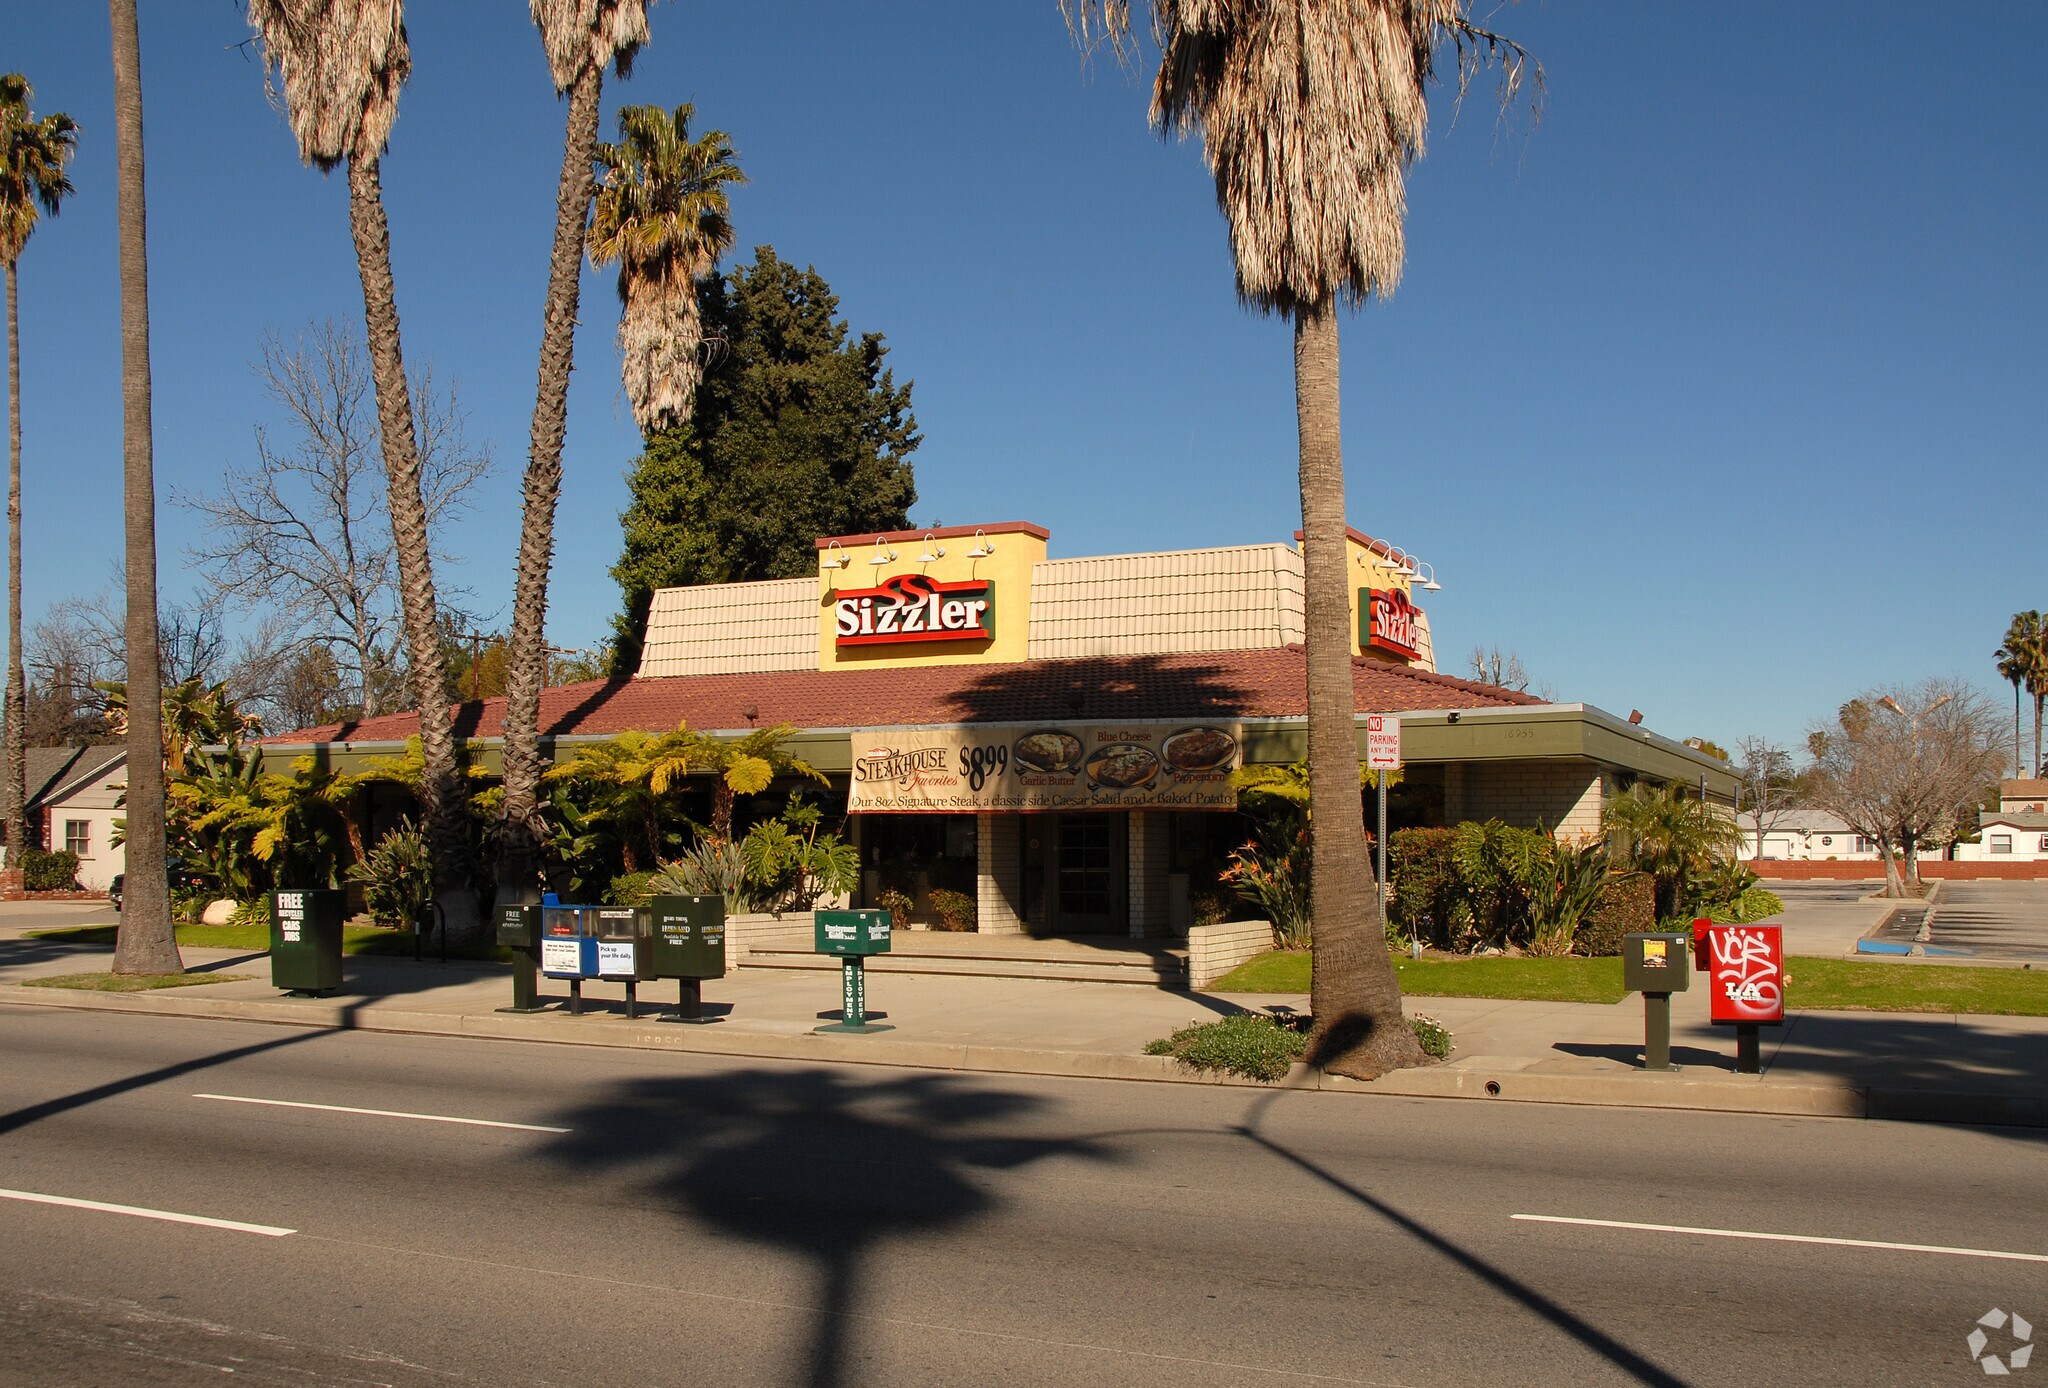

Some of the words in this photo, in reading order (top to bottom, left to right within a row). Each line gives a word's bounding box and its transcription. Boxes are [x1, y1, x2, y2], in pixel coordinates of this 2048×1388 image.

[835, 593, 987, 636] Sizzler
[1376, 600, 1421, 651] Sizzler
[1369, 717, 1381, 730] NO
[1097, 731, 1118, 742] Blue
[1119, 731, 1152, 741] Cheese
[1369, 734, 1398, 745] PARKING
[1384, 747, 1397, 755] TIME
[855, 750, 947, 782] STEAKHOUSE
[898, 769, 959, 792] Favorites
[1020, 776, 1047, 786] Garlic
[1048, 776, 1076, 786] Butter
[851, 796, 873, 807] Our
[875, 796, 897, 807] 8oz.
[898, 795, 948, 809] Signature
[950, 795, 982, 808] Steak,
[983, 798, 989, 806] a
[991, 794, 1026, 806] classic
[1028, 794, 1050, 806] side
[1052, 794, 1090, 806] Caesar
[1091, 792, 1121, 805] Salad
[1123, 792, 1146, 805] and
[1157, 792, 1193, 804] Baked
[1196, 792, 1232, 805] Potato
[278, 893, 304, 909] FREE
[282, 920, 301, 931] CARS
[284, 931, 301, 942] JOBS
[845, 965, 854, 1019] EMPLOYMENT
